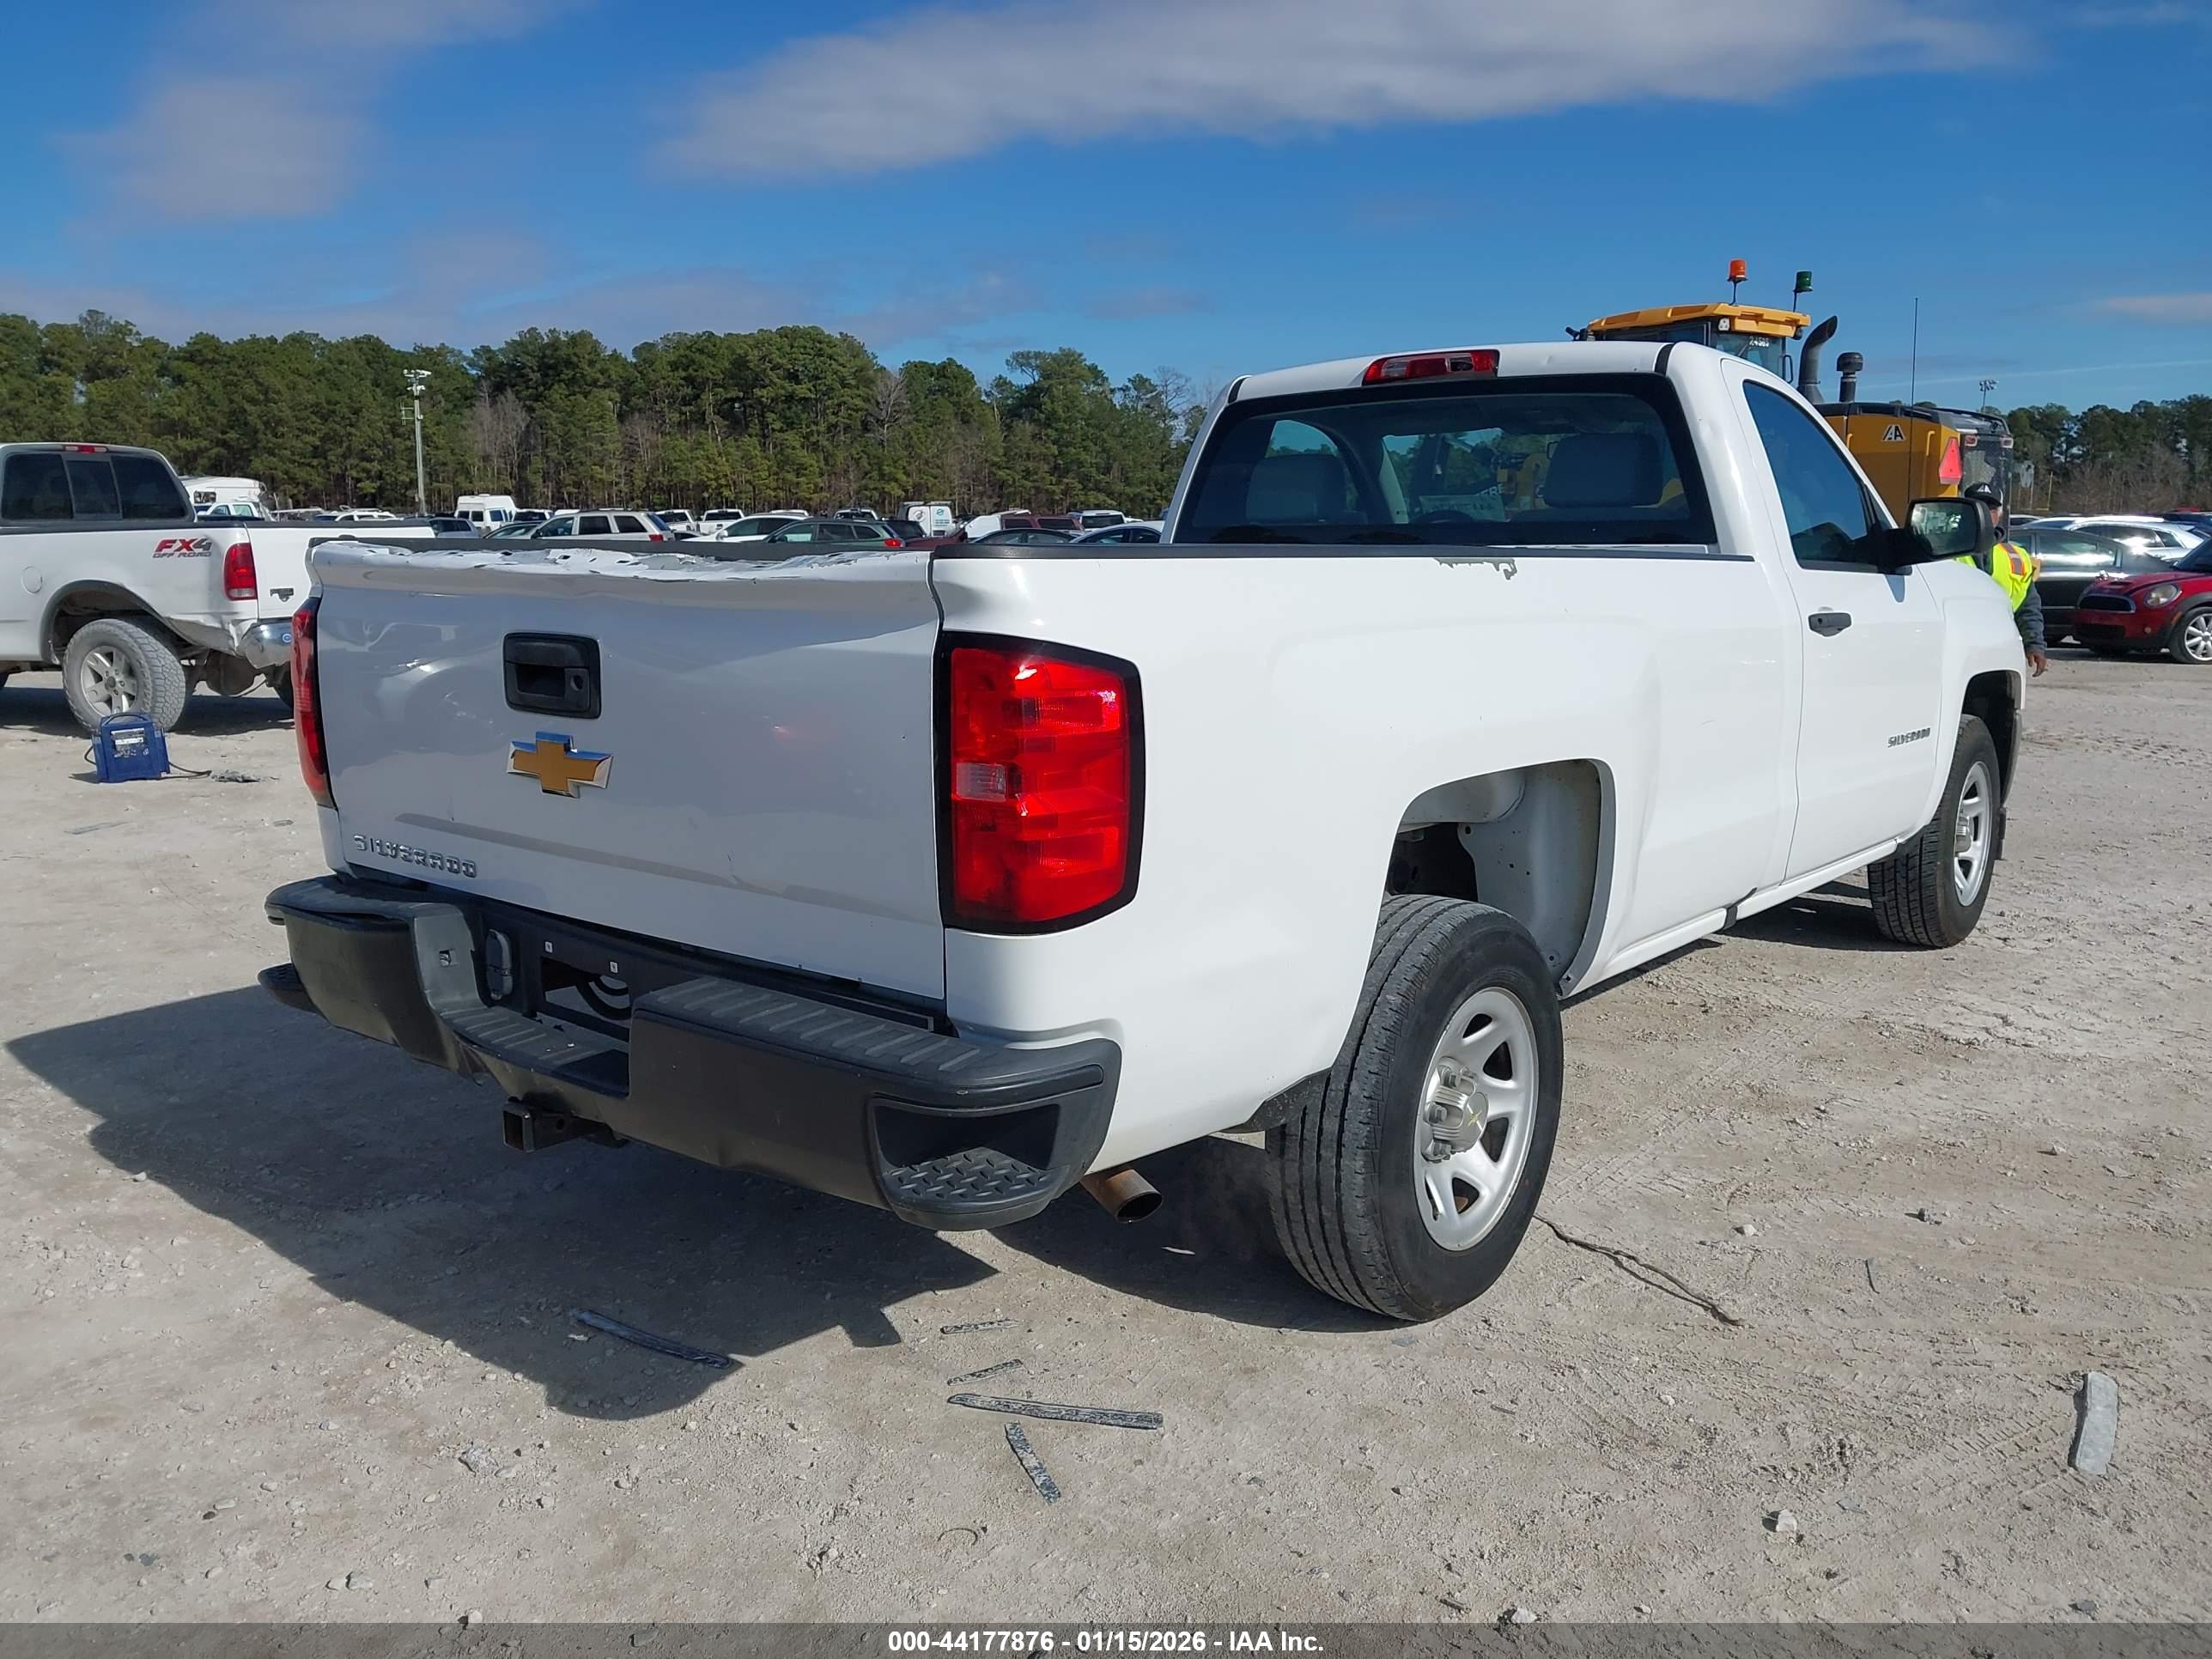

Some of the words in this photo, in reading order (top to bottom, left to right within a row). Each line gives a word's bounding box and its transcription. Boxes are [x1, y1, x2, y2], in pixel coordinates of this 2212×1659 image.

[155, 538, 212, 552] FX4
[1887, 727, 1930, 748] SILVERADO
[354, 834, 477, 878] SILVERADO
